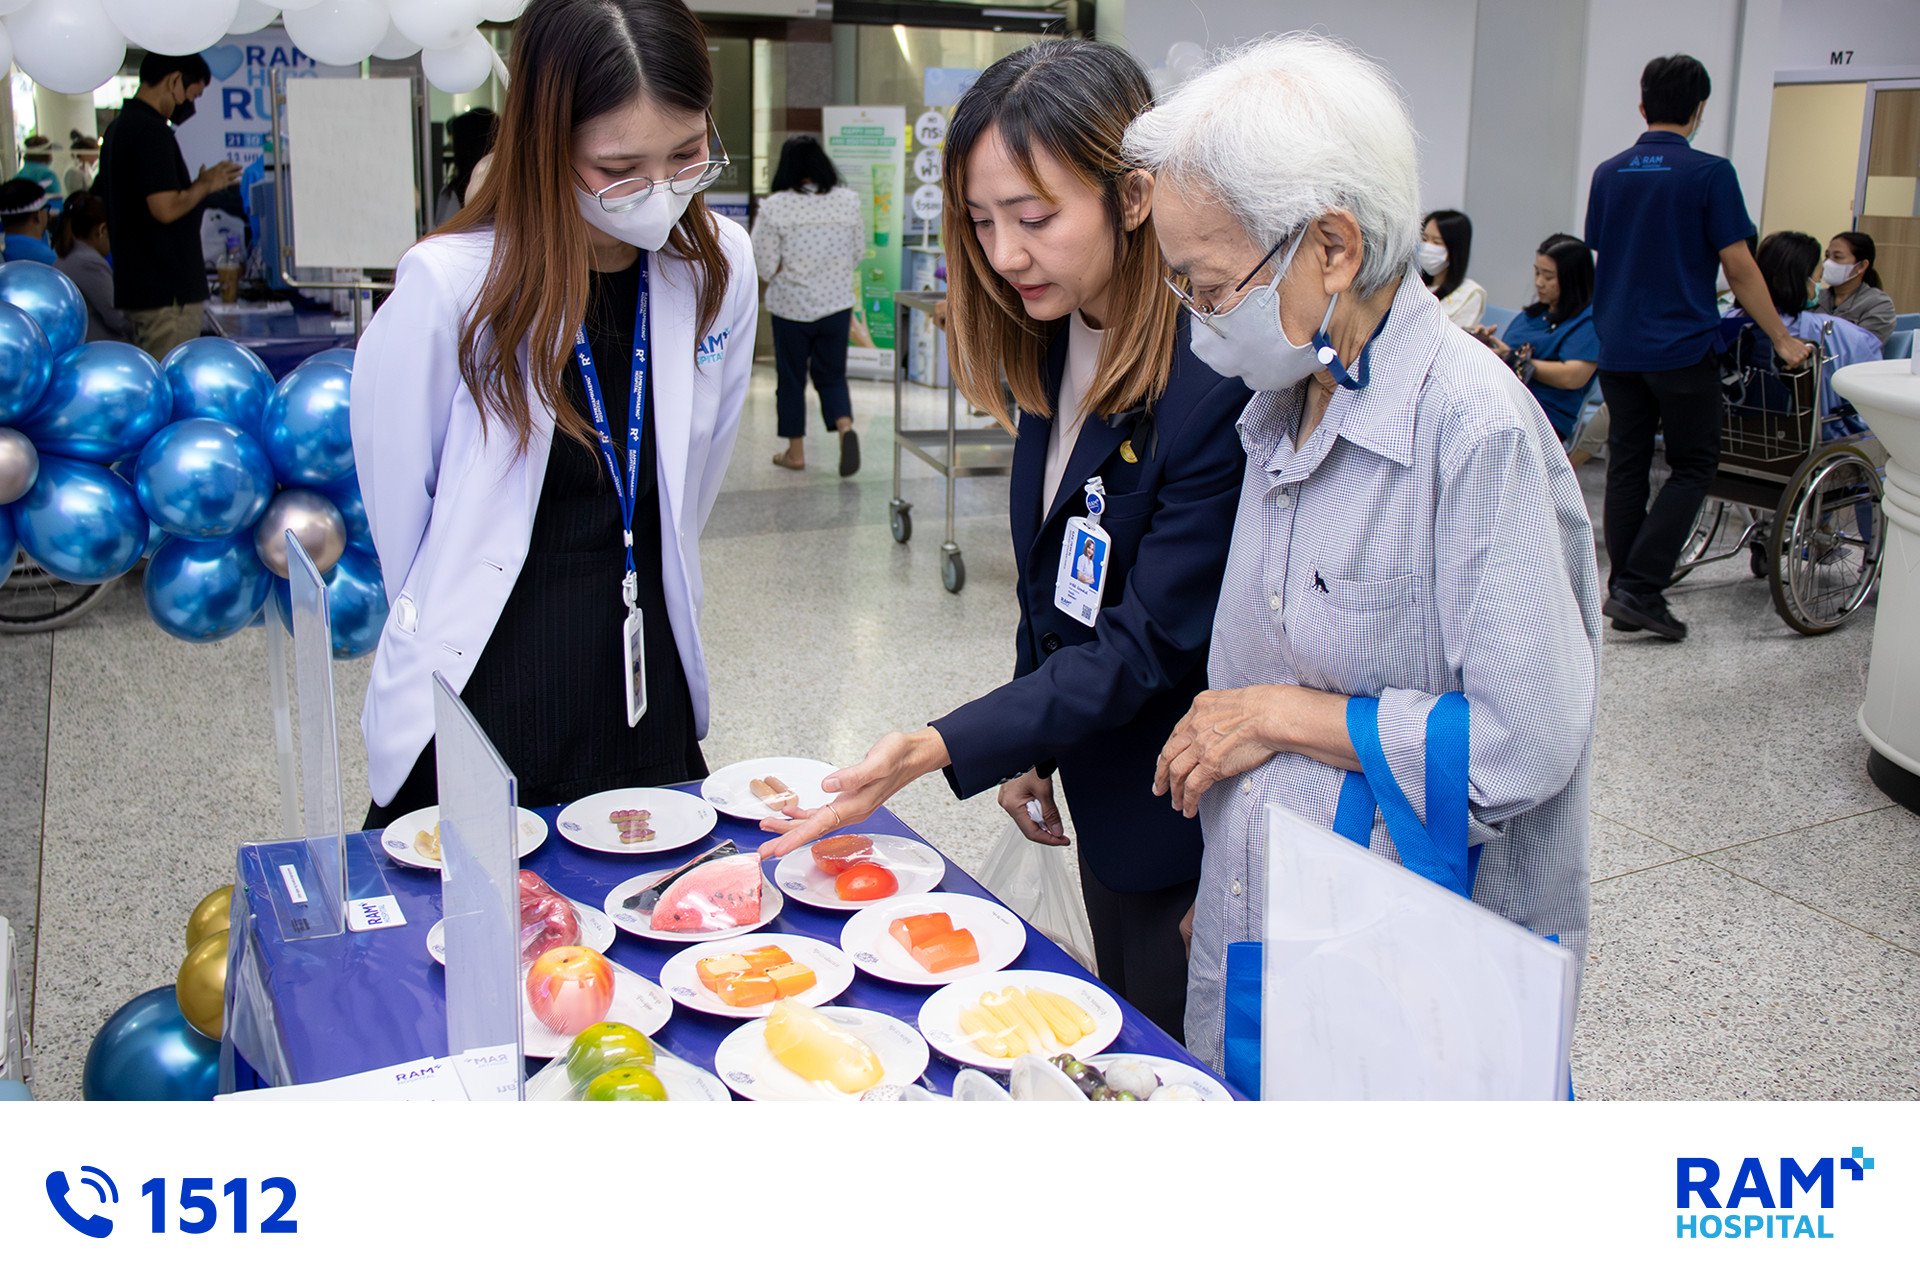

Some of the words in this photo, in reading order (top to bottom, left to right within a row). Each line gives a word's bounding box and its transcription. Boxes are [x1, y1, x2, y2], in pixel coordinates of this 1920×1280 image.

[246, 46, 316, 67] RAM
[1830, 51, 1854, 65] M7
[1642, 155, 1664, 165] RAM
[697, 333, 724, 354] AM
[361, 904, 383, 925] RAM
[395, 1066, 435, 1082] RAM
